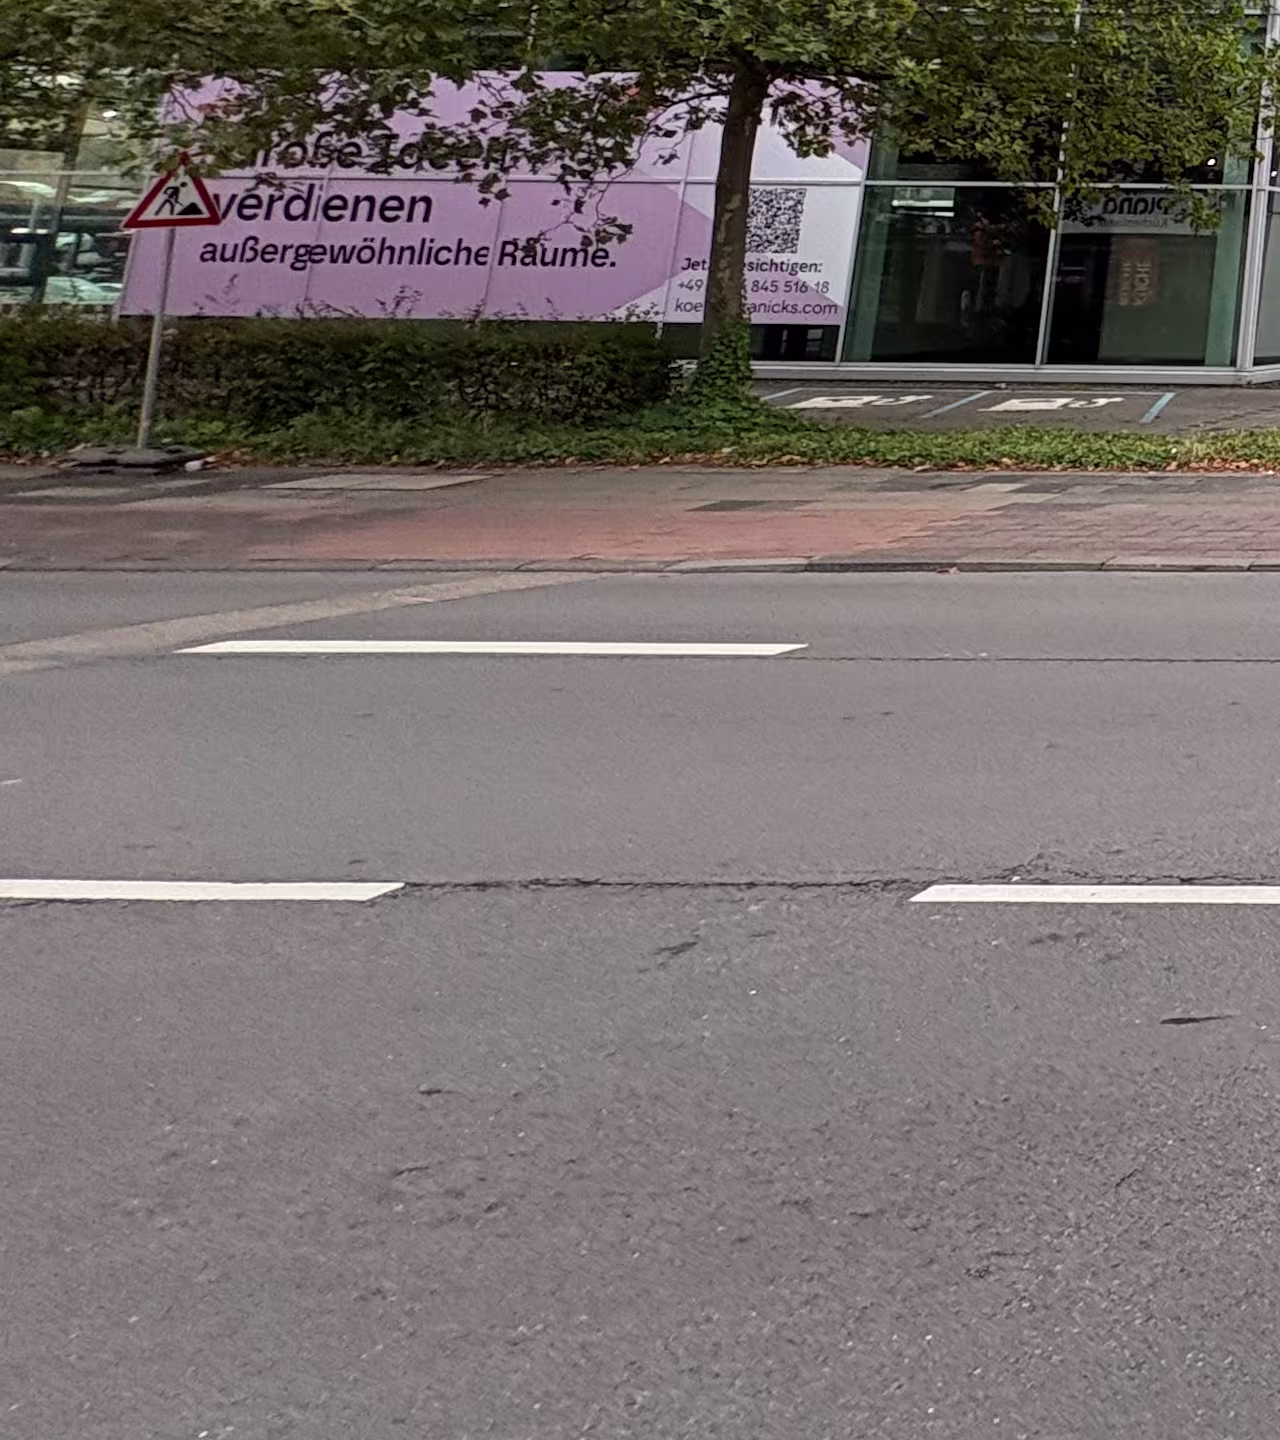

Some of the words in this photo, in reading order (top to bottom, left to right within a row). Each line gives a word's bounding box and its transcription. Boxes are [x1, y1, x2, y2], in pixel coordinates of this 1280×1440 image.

[211, 182, 433, 223] verdienen
[199, 235, 490, 272] außergewöhnliche
[680, 257, 712, 272] Jet
[743, 259, 824, 277] sichtigen:
[677, 278, 704, 292] +49
[750, 279, 779, 293] 845
[783, 280, 809, 294] 516
[813, 281, 830, 294] 18
